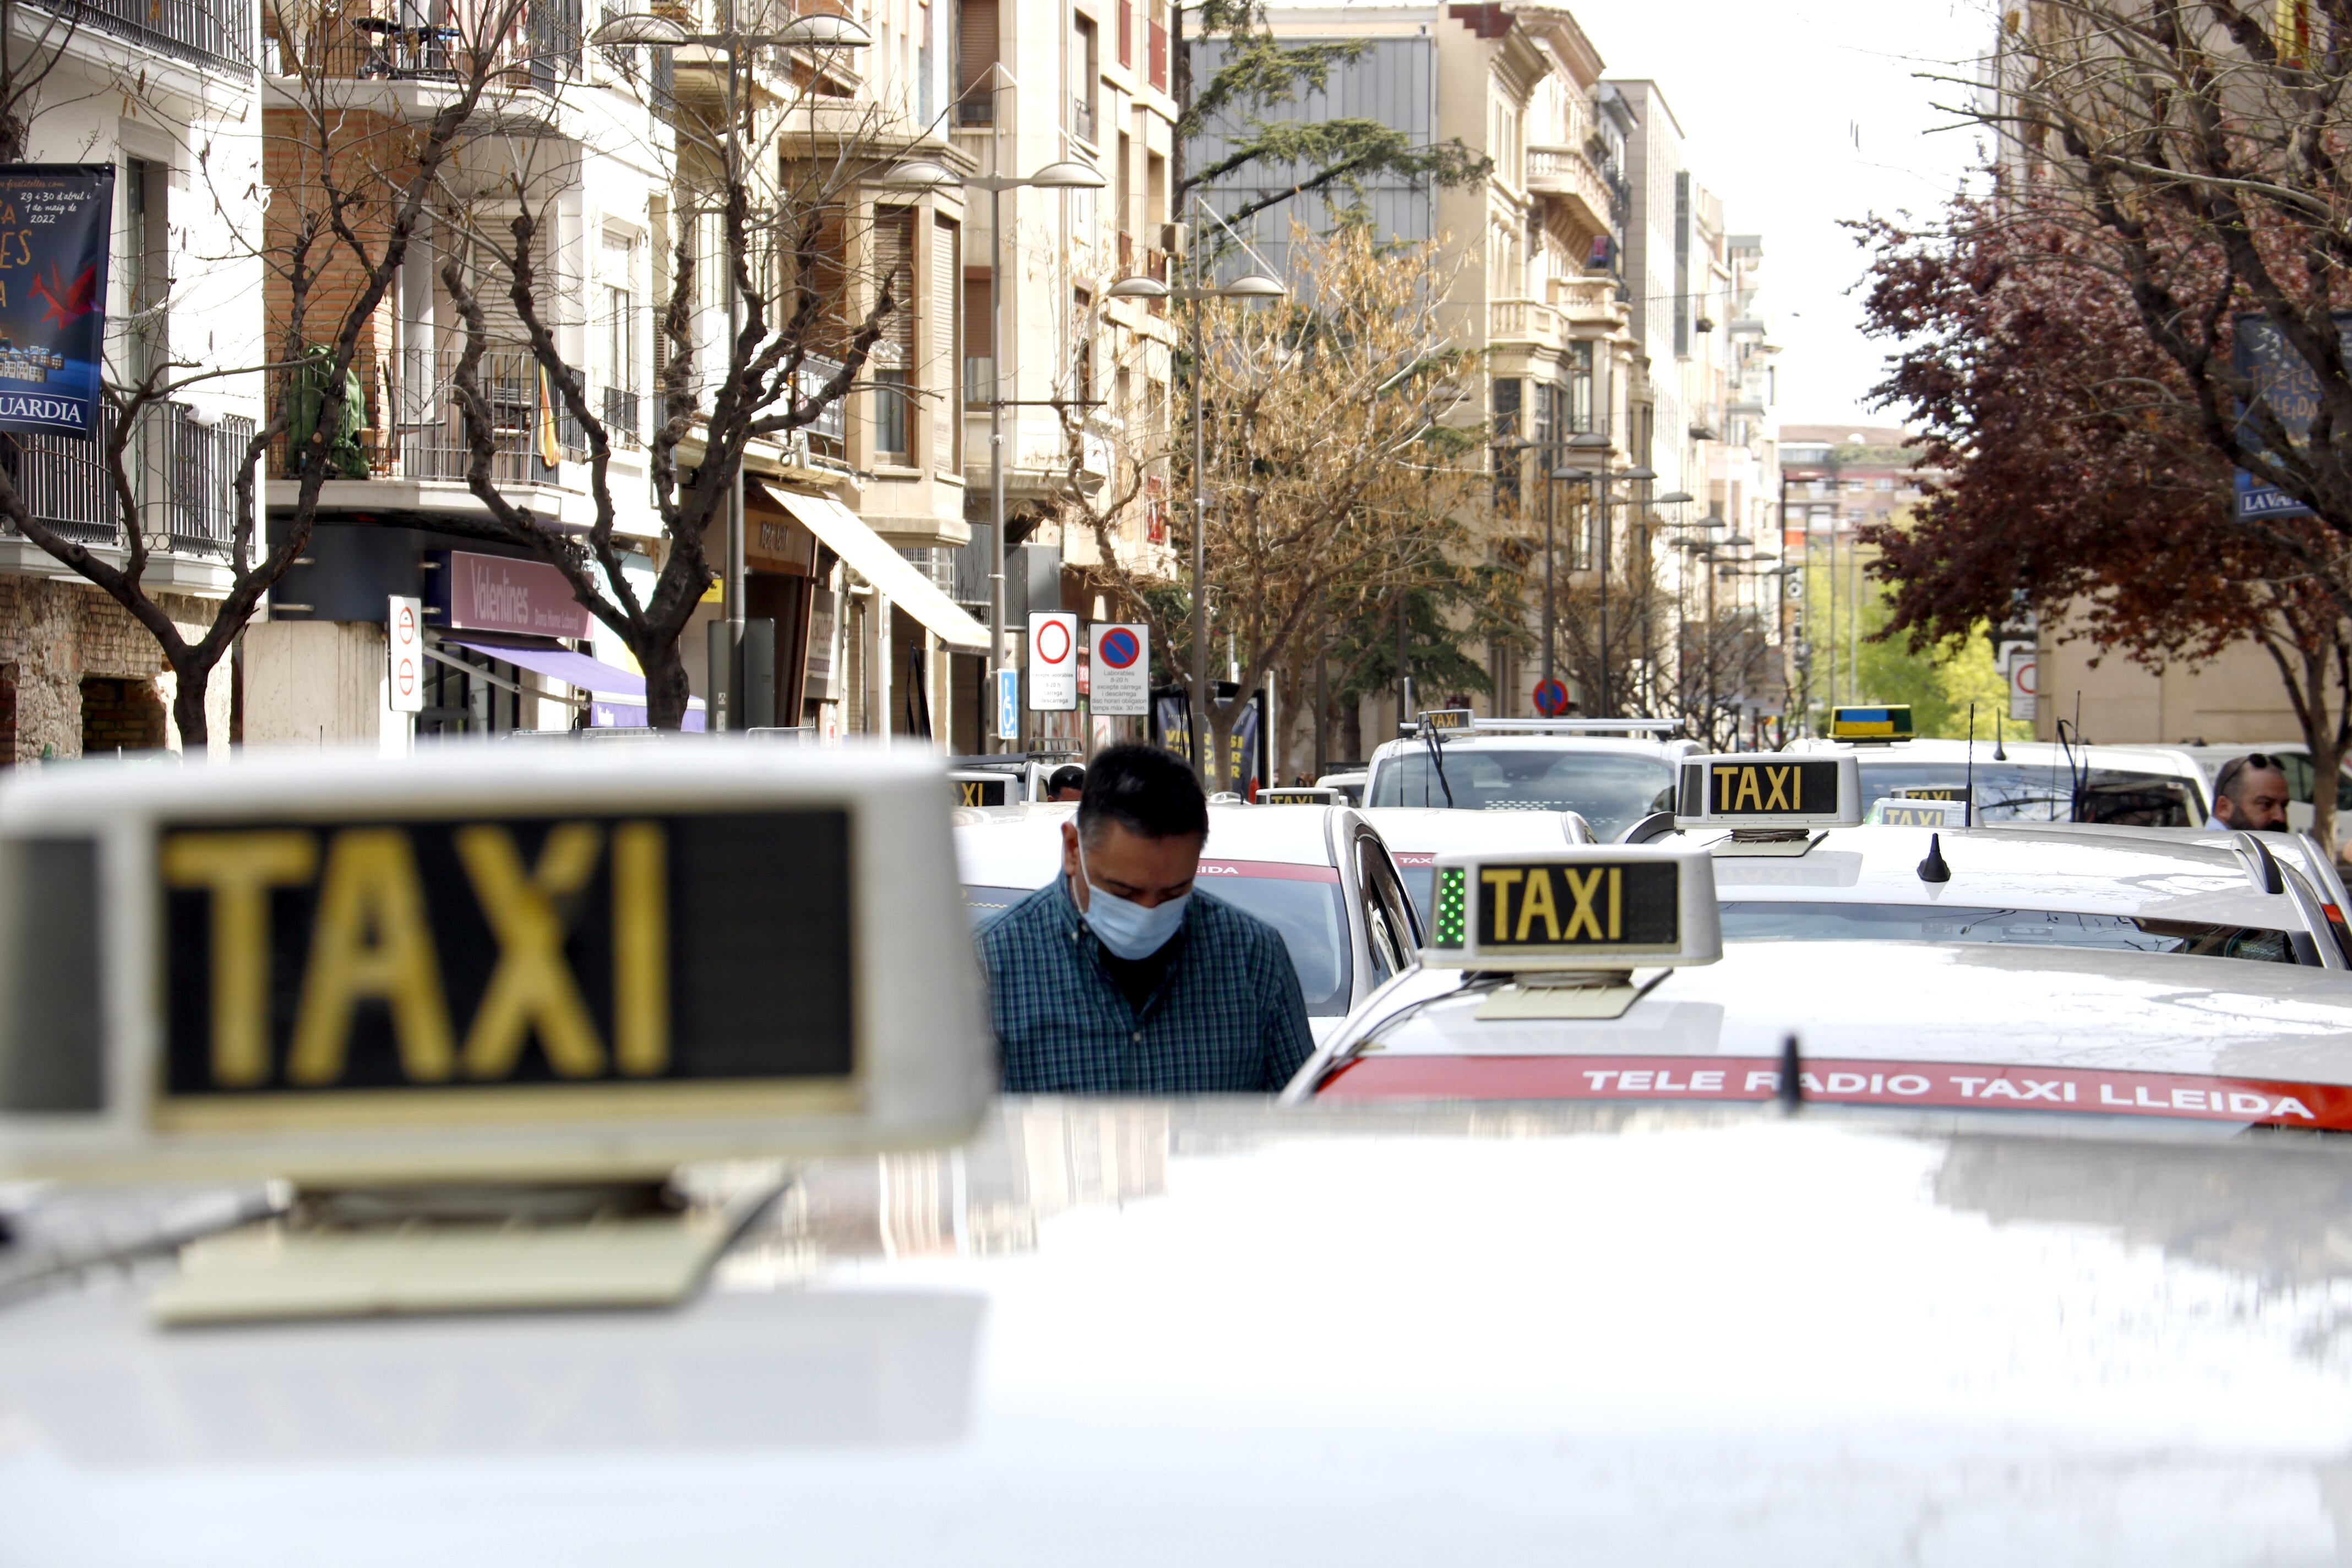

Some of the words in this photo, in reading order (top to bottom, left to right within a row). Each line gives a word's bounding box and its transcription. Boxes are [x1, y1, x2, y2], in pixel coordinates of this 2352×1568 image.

[21, 192, 32, 202] 29
[42, 192, 55, 202] 30
[30, 214, 55, 224] 2022
[45, 204, 66, 214] maig
[68, 203, 77, 212] de
[471, 557, 529, 624] Valentines
[1430, 713, 1458, 728] TAXI
[1713, 766, 1801, 810] TAXI
[1481, 868, 1621, 941] TAXI
[164, 824, 668, 1086] TAXI
[1582, 1070, 1725, 1091] TELE
[1744, 1071, 1930, 1095] RADIO
[1950, 1076, 2076, 1102] TAXI
[2101, 1084, 2315, 1119] LLEIDA
